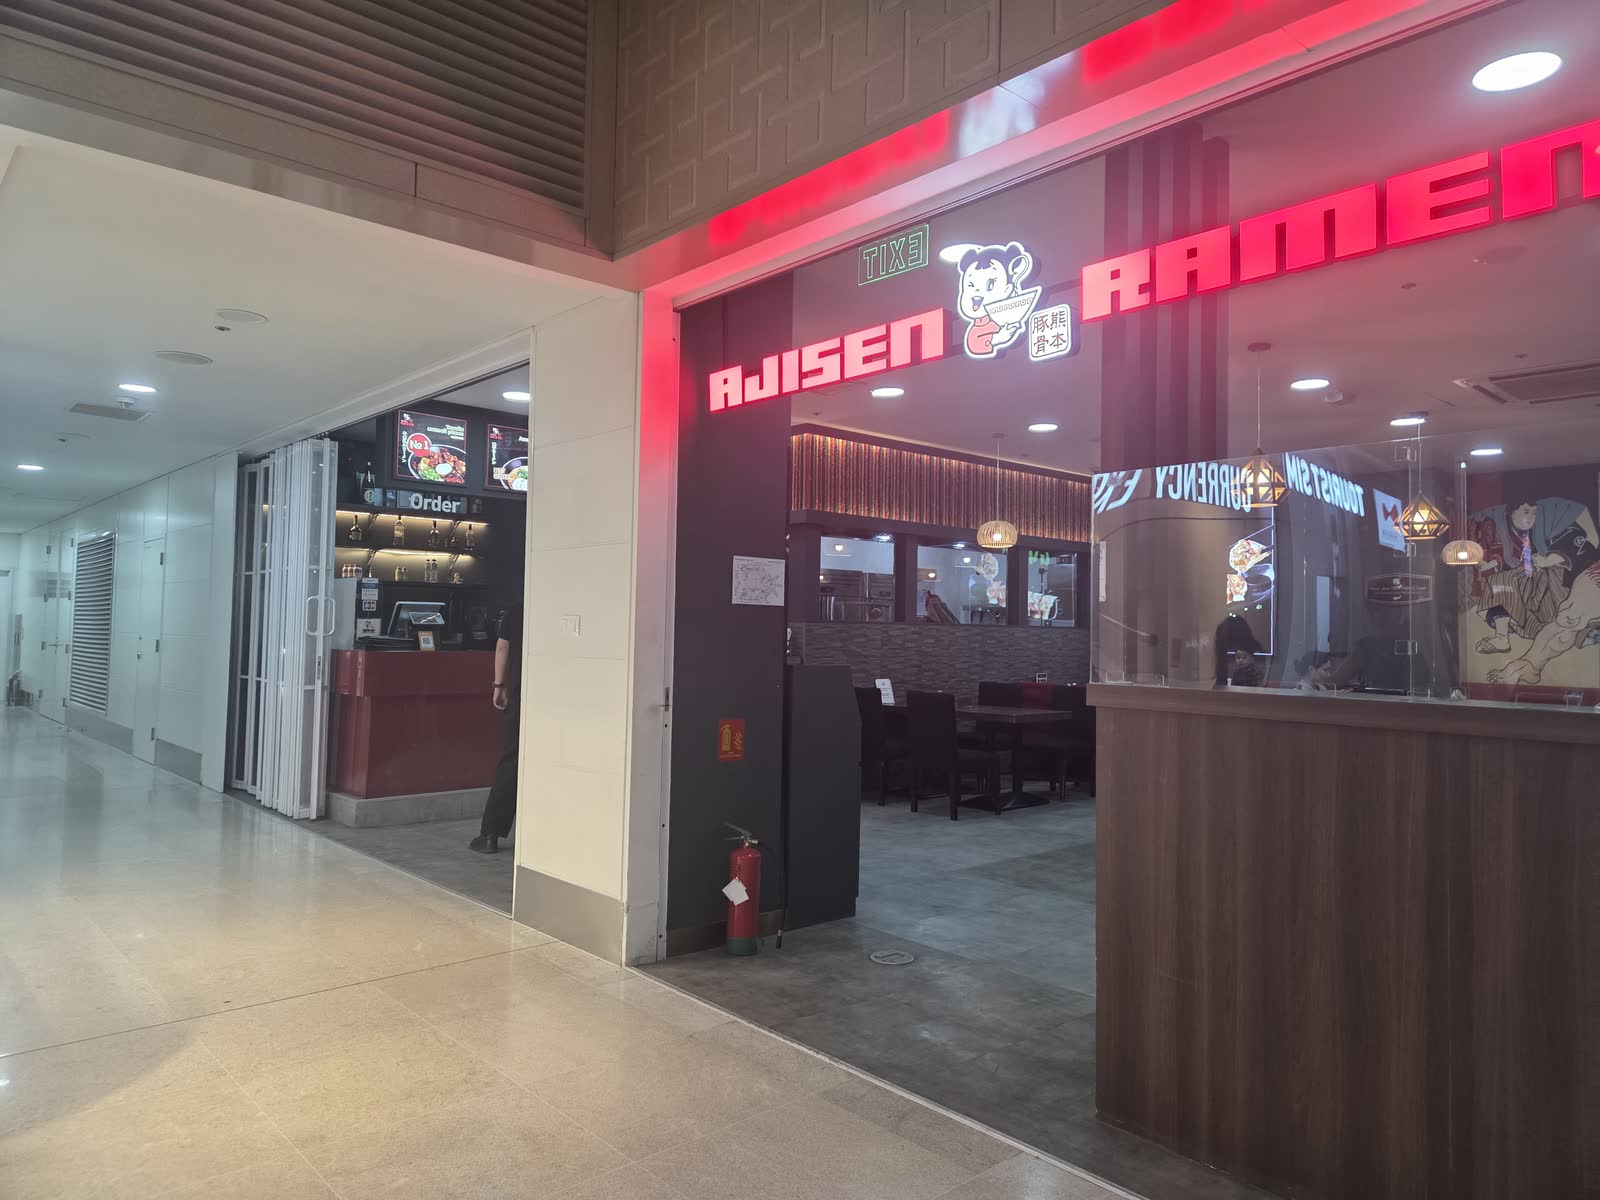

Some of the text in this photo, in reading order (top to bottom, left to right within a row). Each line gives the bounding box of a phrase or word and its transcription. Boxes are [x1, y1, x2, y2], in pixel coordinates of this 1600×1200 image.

[709, 119, 1600, 412] AJISEN RAMEN
[1032, 314, 1050, 355] 豚骨
[1049, 310, 1067, 349] 熊本
[410, 492, 461, 513] Order
